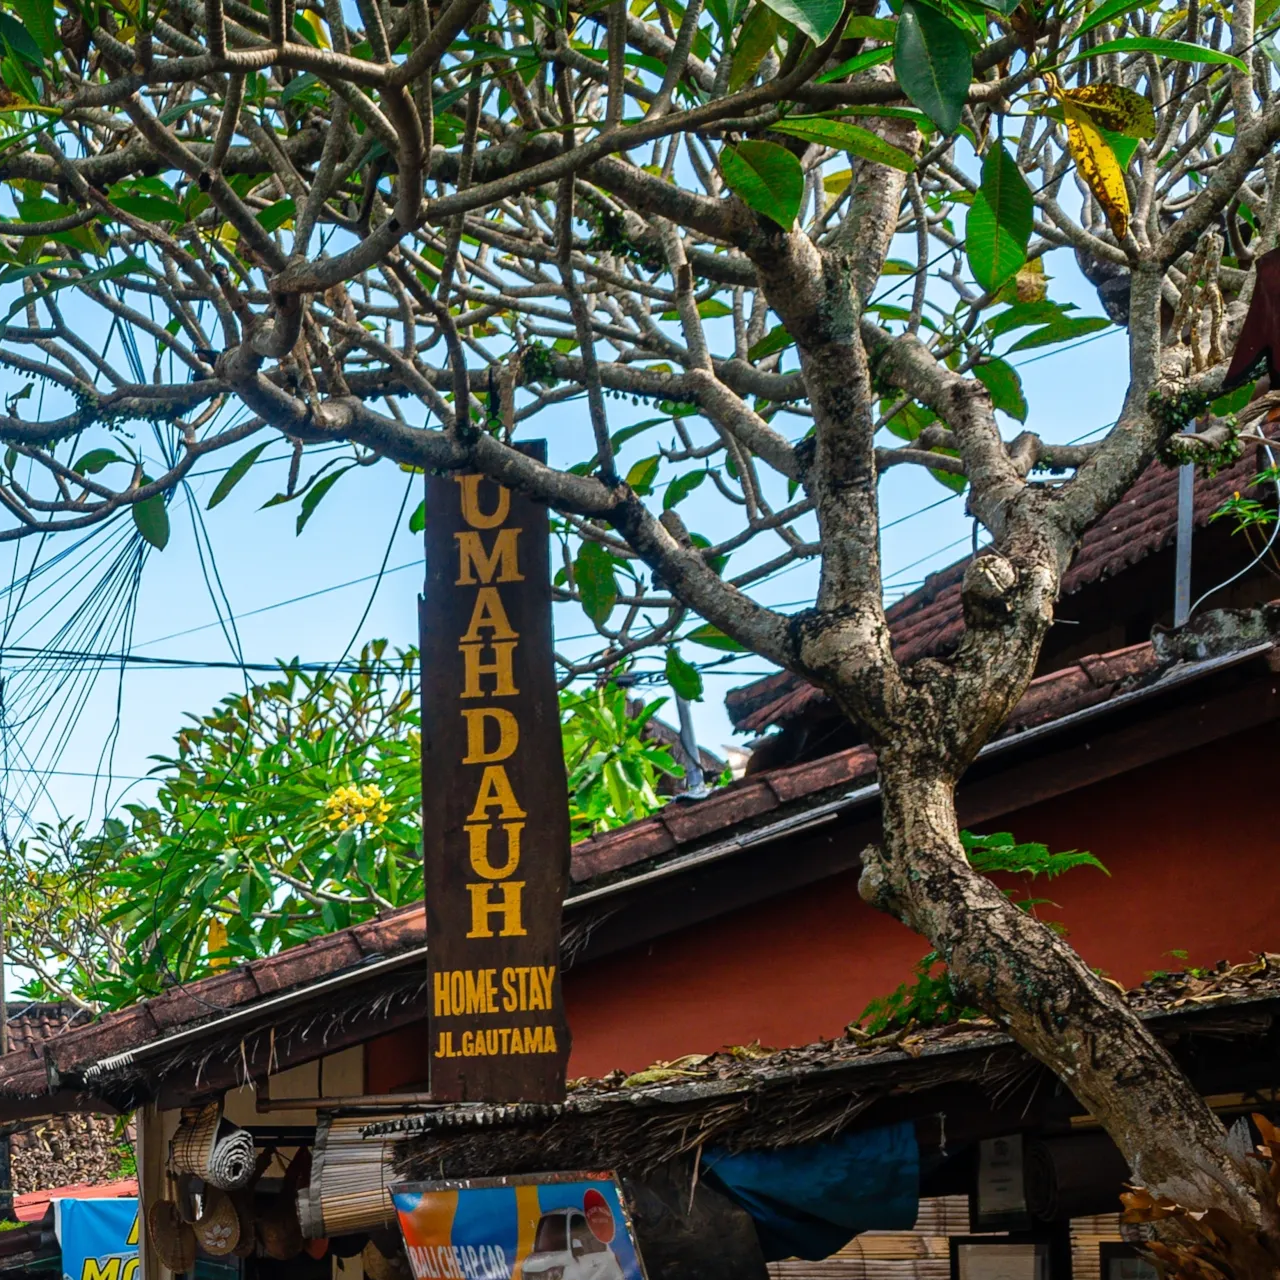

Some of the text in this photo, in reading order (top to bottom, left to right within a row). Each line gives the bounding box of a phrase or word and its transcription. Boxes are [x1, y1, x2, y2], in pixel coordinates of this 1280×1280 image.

[434, 964, 556, 1017] HOME STAY
[408, 1244, 511, 1280] BALI CHEAP CAR
